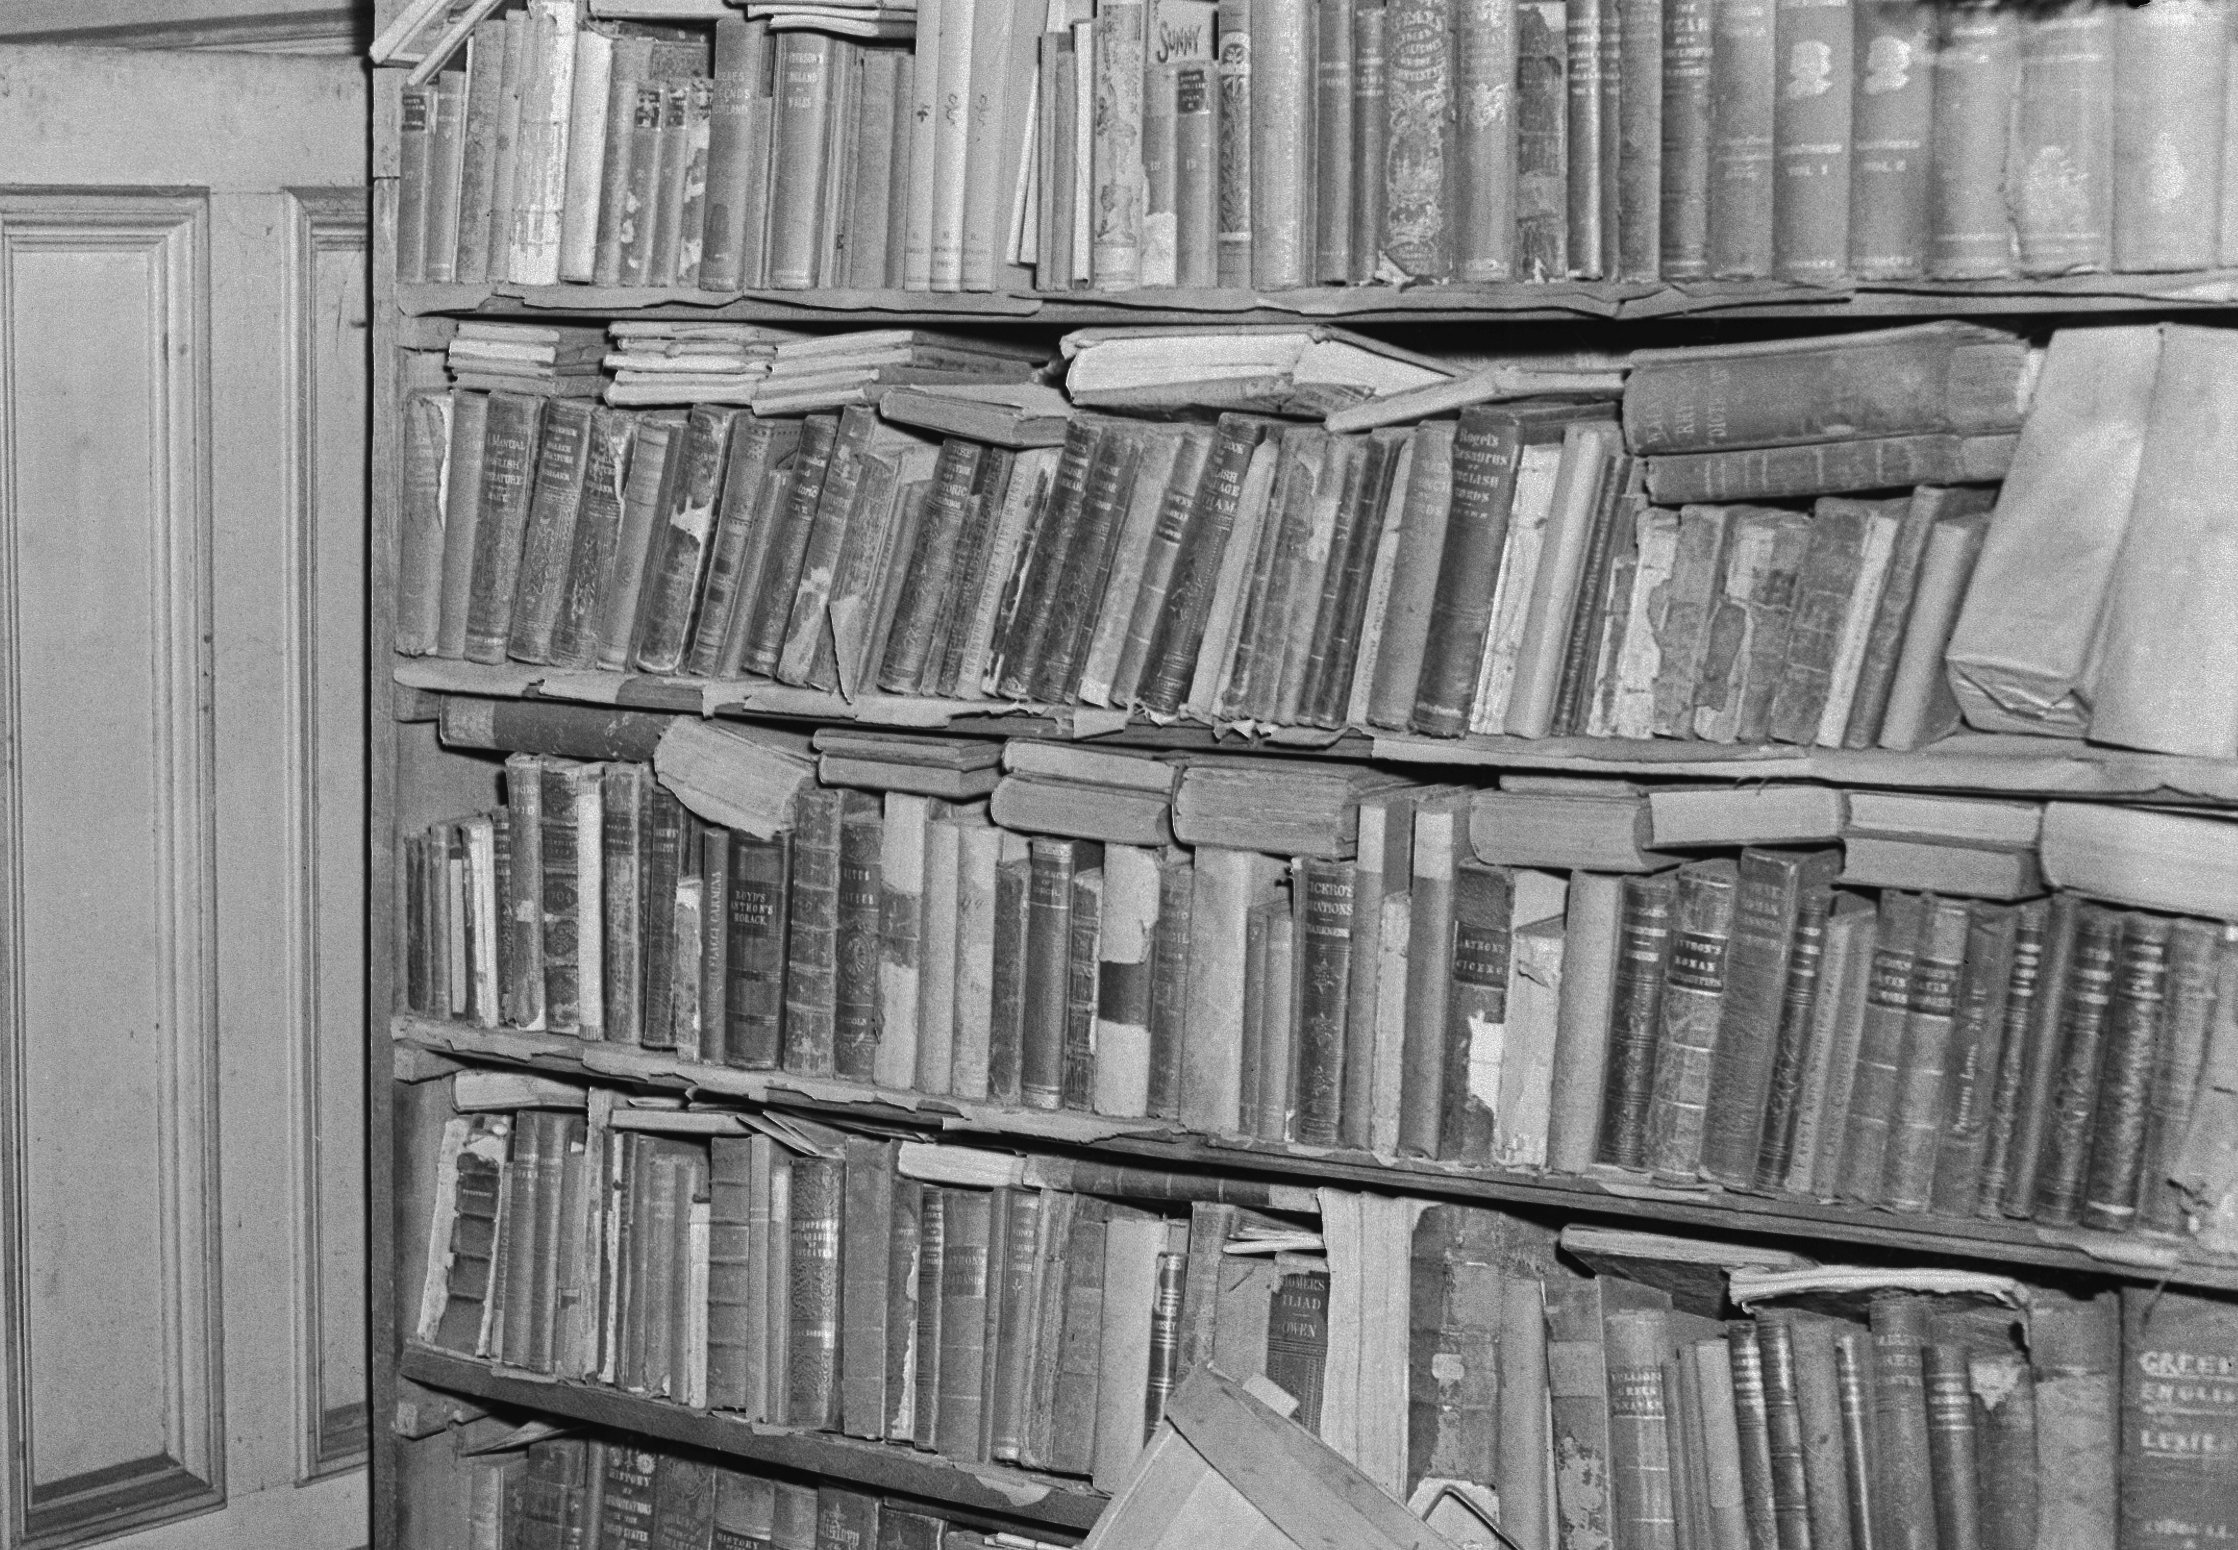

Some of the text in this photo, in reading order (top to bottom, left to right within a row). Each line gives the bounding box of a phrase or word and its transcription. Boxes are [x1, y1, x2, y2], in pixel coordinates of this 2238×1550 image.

[1157, 21, 1201, 63] SUNNY
[1283, 1294, 1322, 1310] ILIAD
[1282, 1322, 1317, 1338] OWEN
[2140, 1381, 2237, 1403] ENGLIS
[624, 1527, 648, 1542] STATES
[717, 1532, 760, 1549] HISTORY
